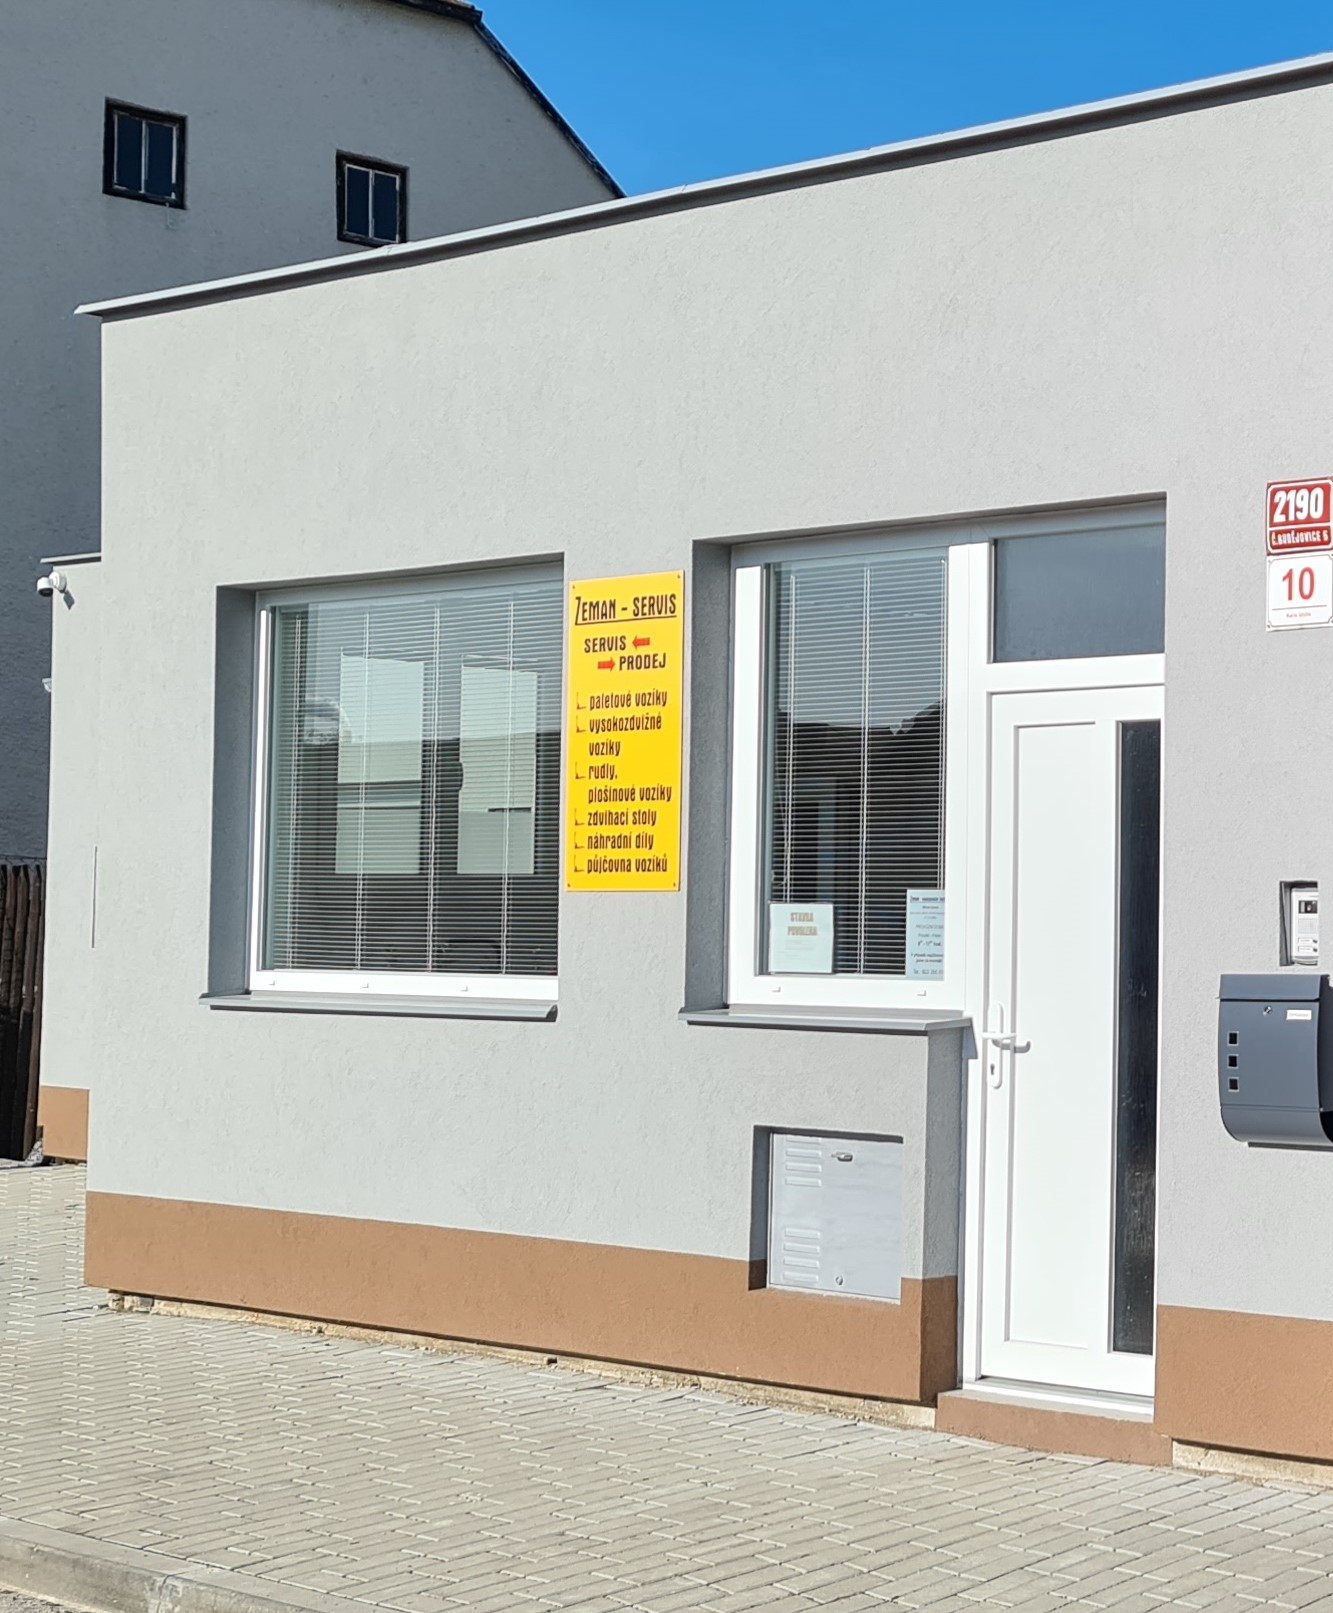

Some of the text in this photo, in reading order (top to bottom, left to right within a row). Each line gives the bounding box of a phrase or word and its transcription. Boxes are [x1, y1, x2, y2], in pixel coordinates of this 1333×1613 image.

[1273, 486, 1324, 523] 2190
[1322, 529, 1329, 542] 5
[1282, 566, 1315, 601] 10
[575, 596, 616, 626] ZEMAN
[633, 593, 676, 618] SERVIS
[584, 635, 627, 653] SERVIS
[619, 652, 667, 671] PRODEJ
[589, 688, 668, 711] paletové vozíky
[589, 711, 662, 734] vysokozdvižné
[588, 738, 621, 756] vozíky
[588, 783, 672, 804] plošinové vozíky
[587, 808, 657, 826] zdvihací stoly
[587, 831, 654, 850] náhradní díly
[587, 853, 668, 874] půjčovna vozíků
